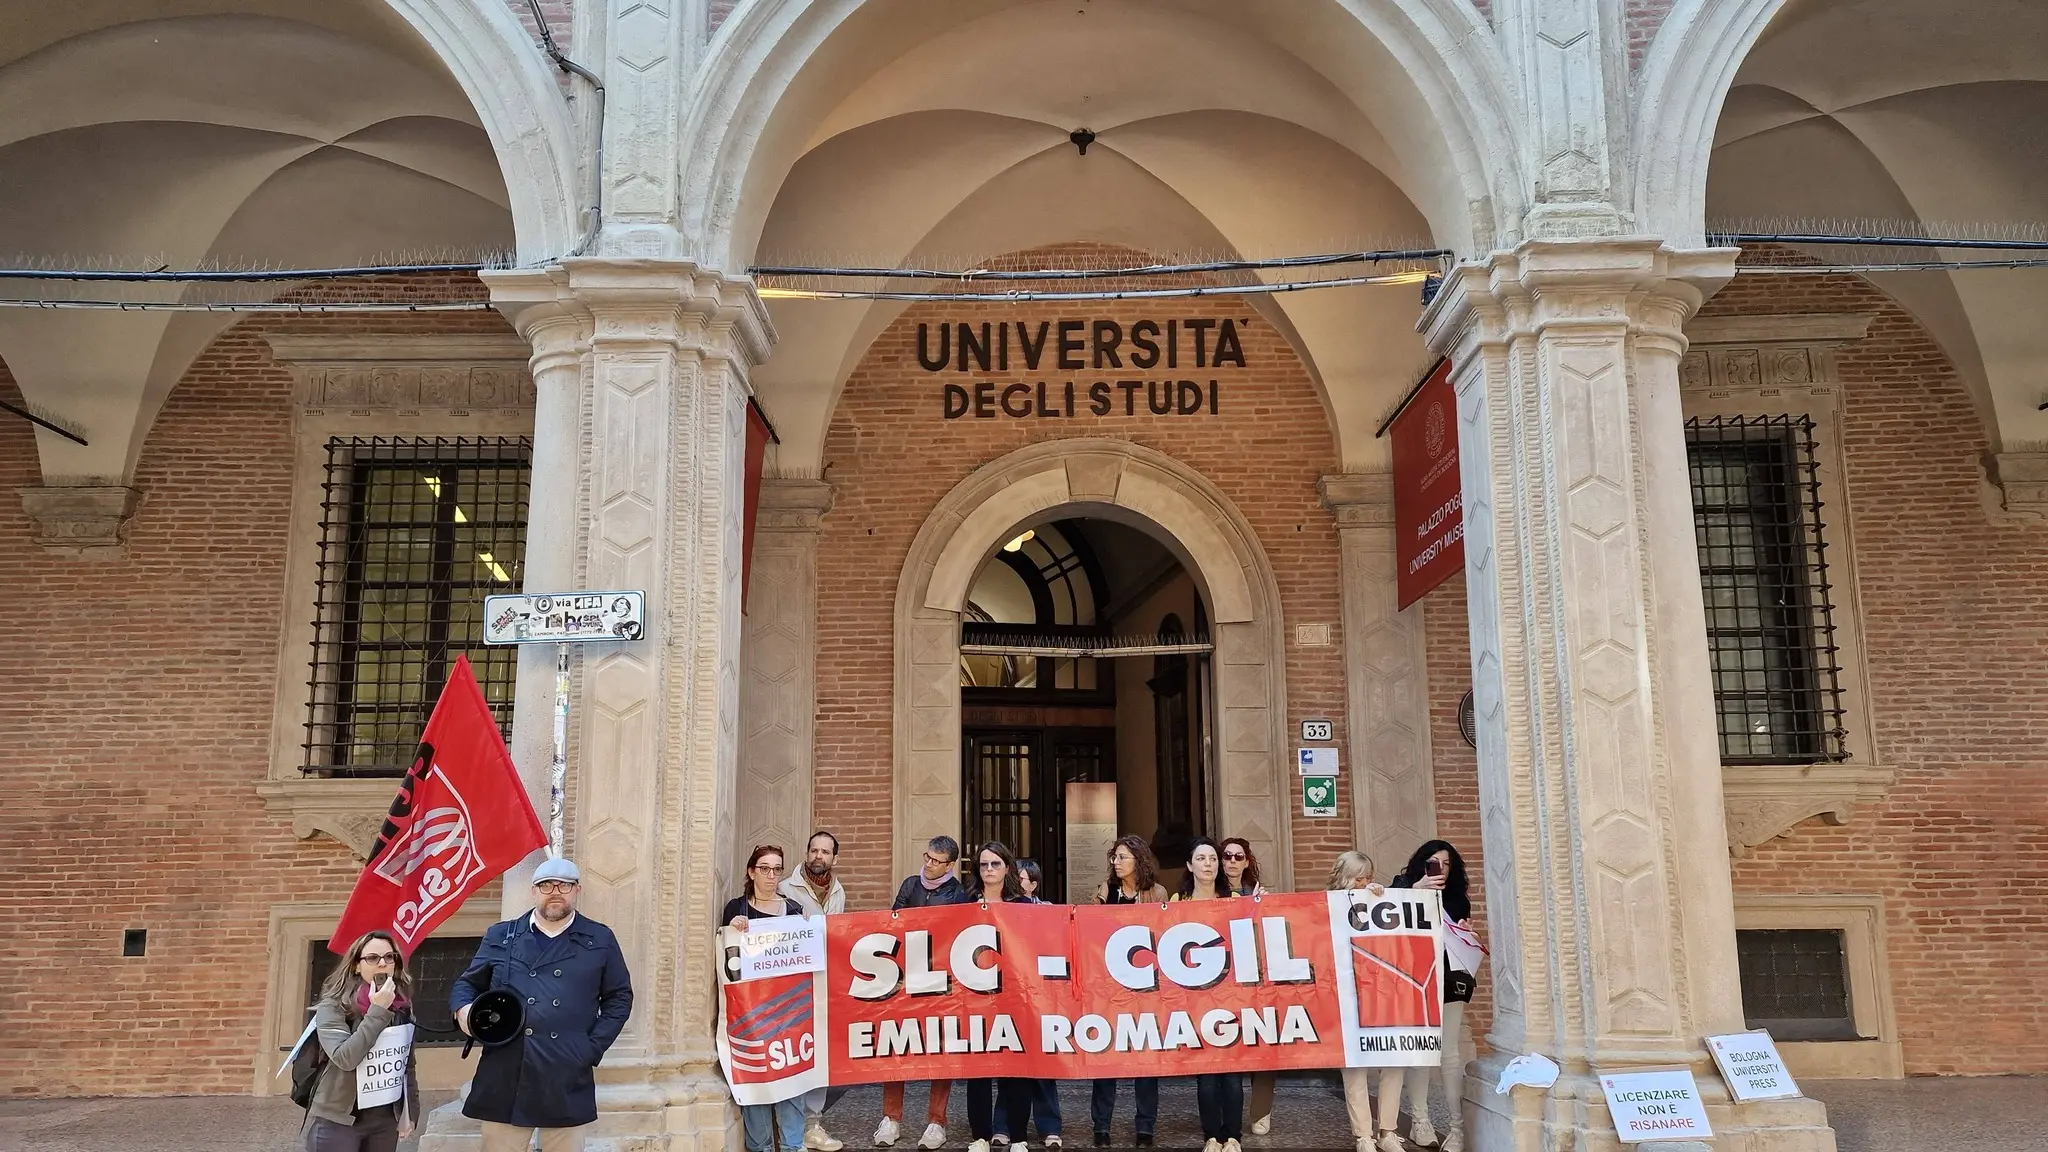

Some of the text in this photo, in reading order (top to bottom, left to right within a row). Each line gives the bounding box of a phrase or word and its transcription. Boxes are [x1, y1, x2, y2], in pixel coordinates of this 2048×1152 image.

[944, 379, 1219, 419] DEGLI STUDI
[1417, 505, 1444, 541] PALAZZO
[1408, 540, 1444, 576] UNIVERSITY
[555, 598, 572, 607] via
[1307, 724, 1328, 738] 33
[1347, 901, 1432, 932] CGIL
[747, 929, 814, 946] LICENZIARE
[764, 942, 799, 957] NON È
[753, 955, 812, 971] RISANARE
[848, 924, 1001, 1000] SLC
[1104, 915, 1316, 992] CGIL
[848, 1004, 1319, 1059] EMILIA ROMAGNA
[1359, 1035, 1397, 1052] EMILIA
[768, 1032, 815, 1071] SLC
[1729, 1051, 1771, 1063] BOLOGNA
[1732, 1063, 1780, 1077] UNIVERSITY
[362, 1081, 374, 1092] AI
[1749, 1078, 1778, 1090] PRESS
[1615, 1089, 1690, 1103] LICENZIARE
[1637, 1102, 1678, 1116] NON È
[1629, 1117, 1695, 1131] RISANARE
